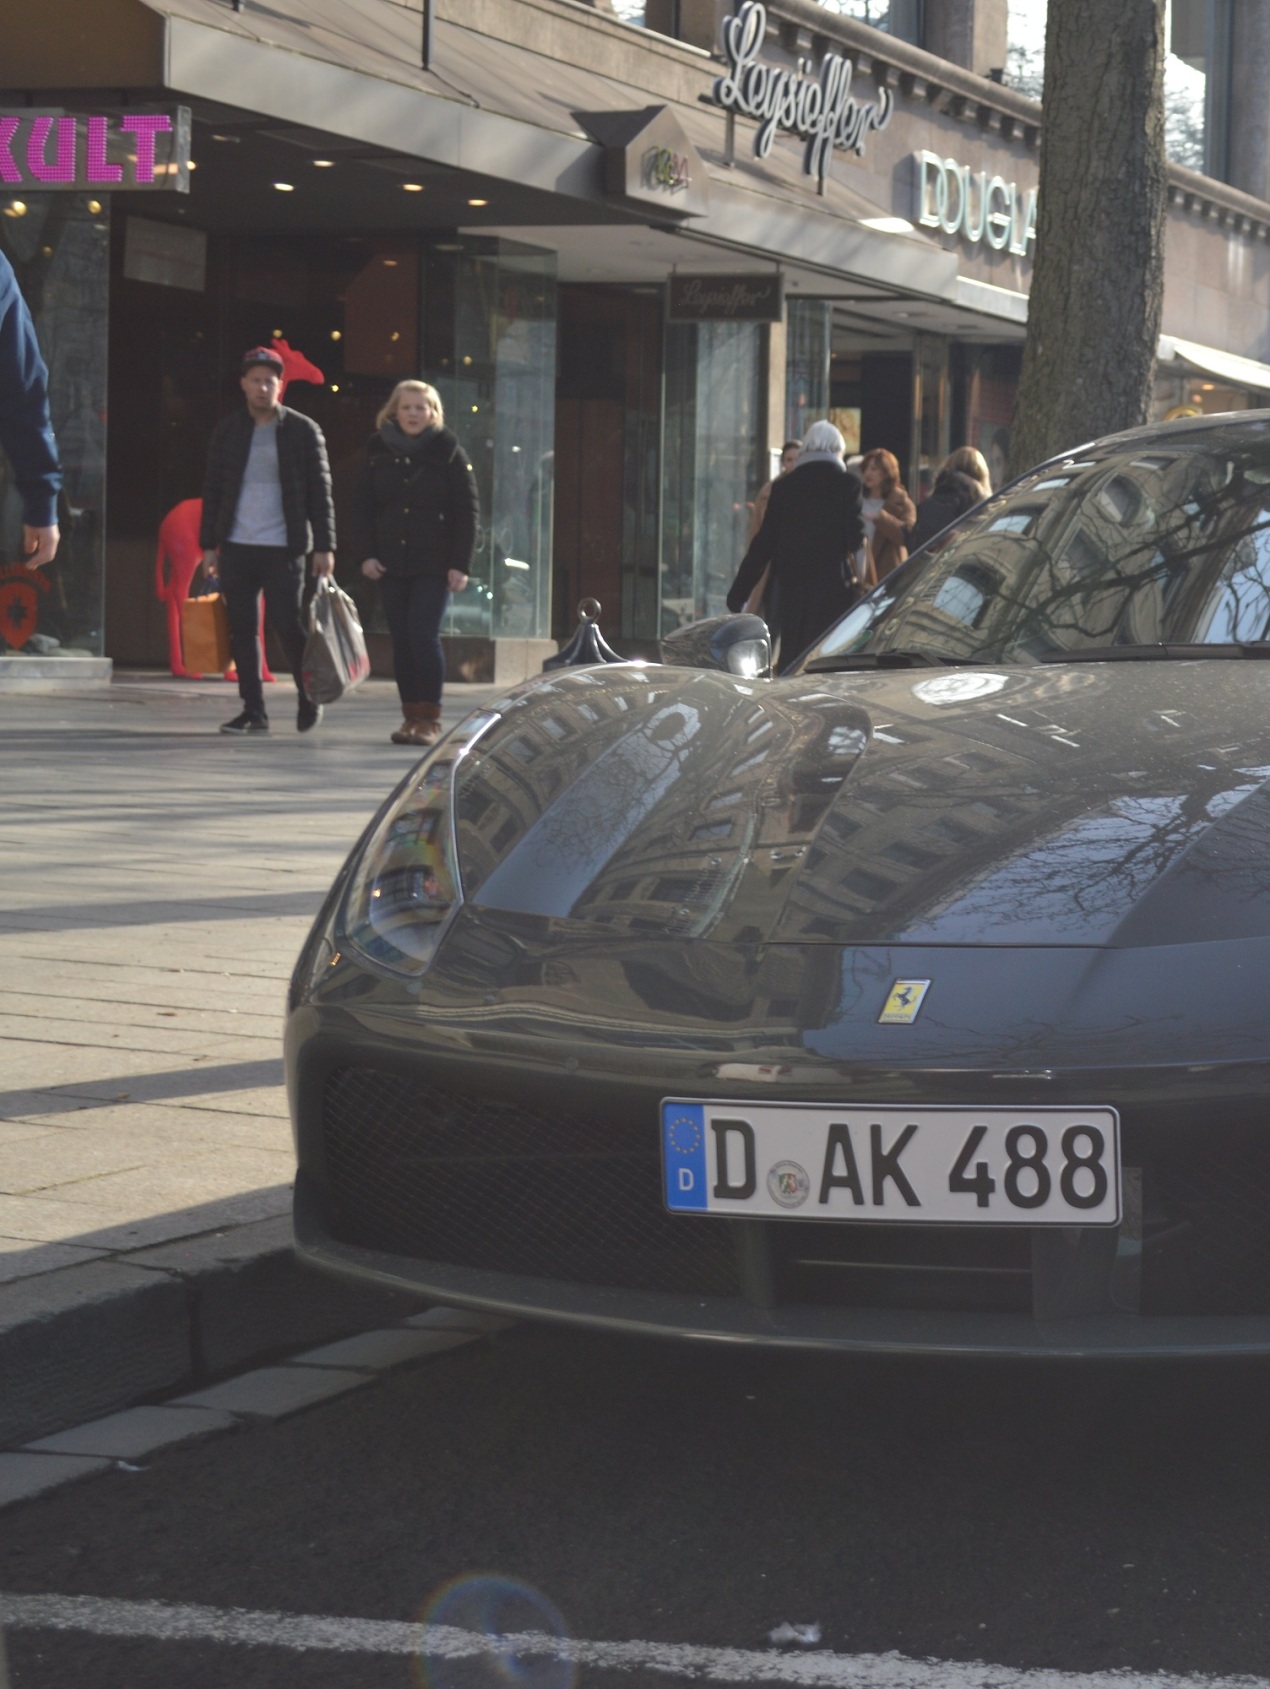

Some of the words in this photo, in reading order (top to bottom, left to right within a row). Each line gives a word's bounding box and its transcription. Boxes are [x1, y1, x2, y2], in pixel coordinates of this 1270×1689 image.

[678, 1167, 694, 1191] D
[710, 1118, 757, 1200] D
[818, 1123, 921, 1206] AK
[948, 1125, 1108, 1210] 488
